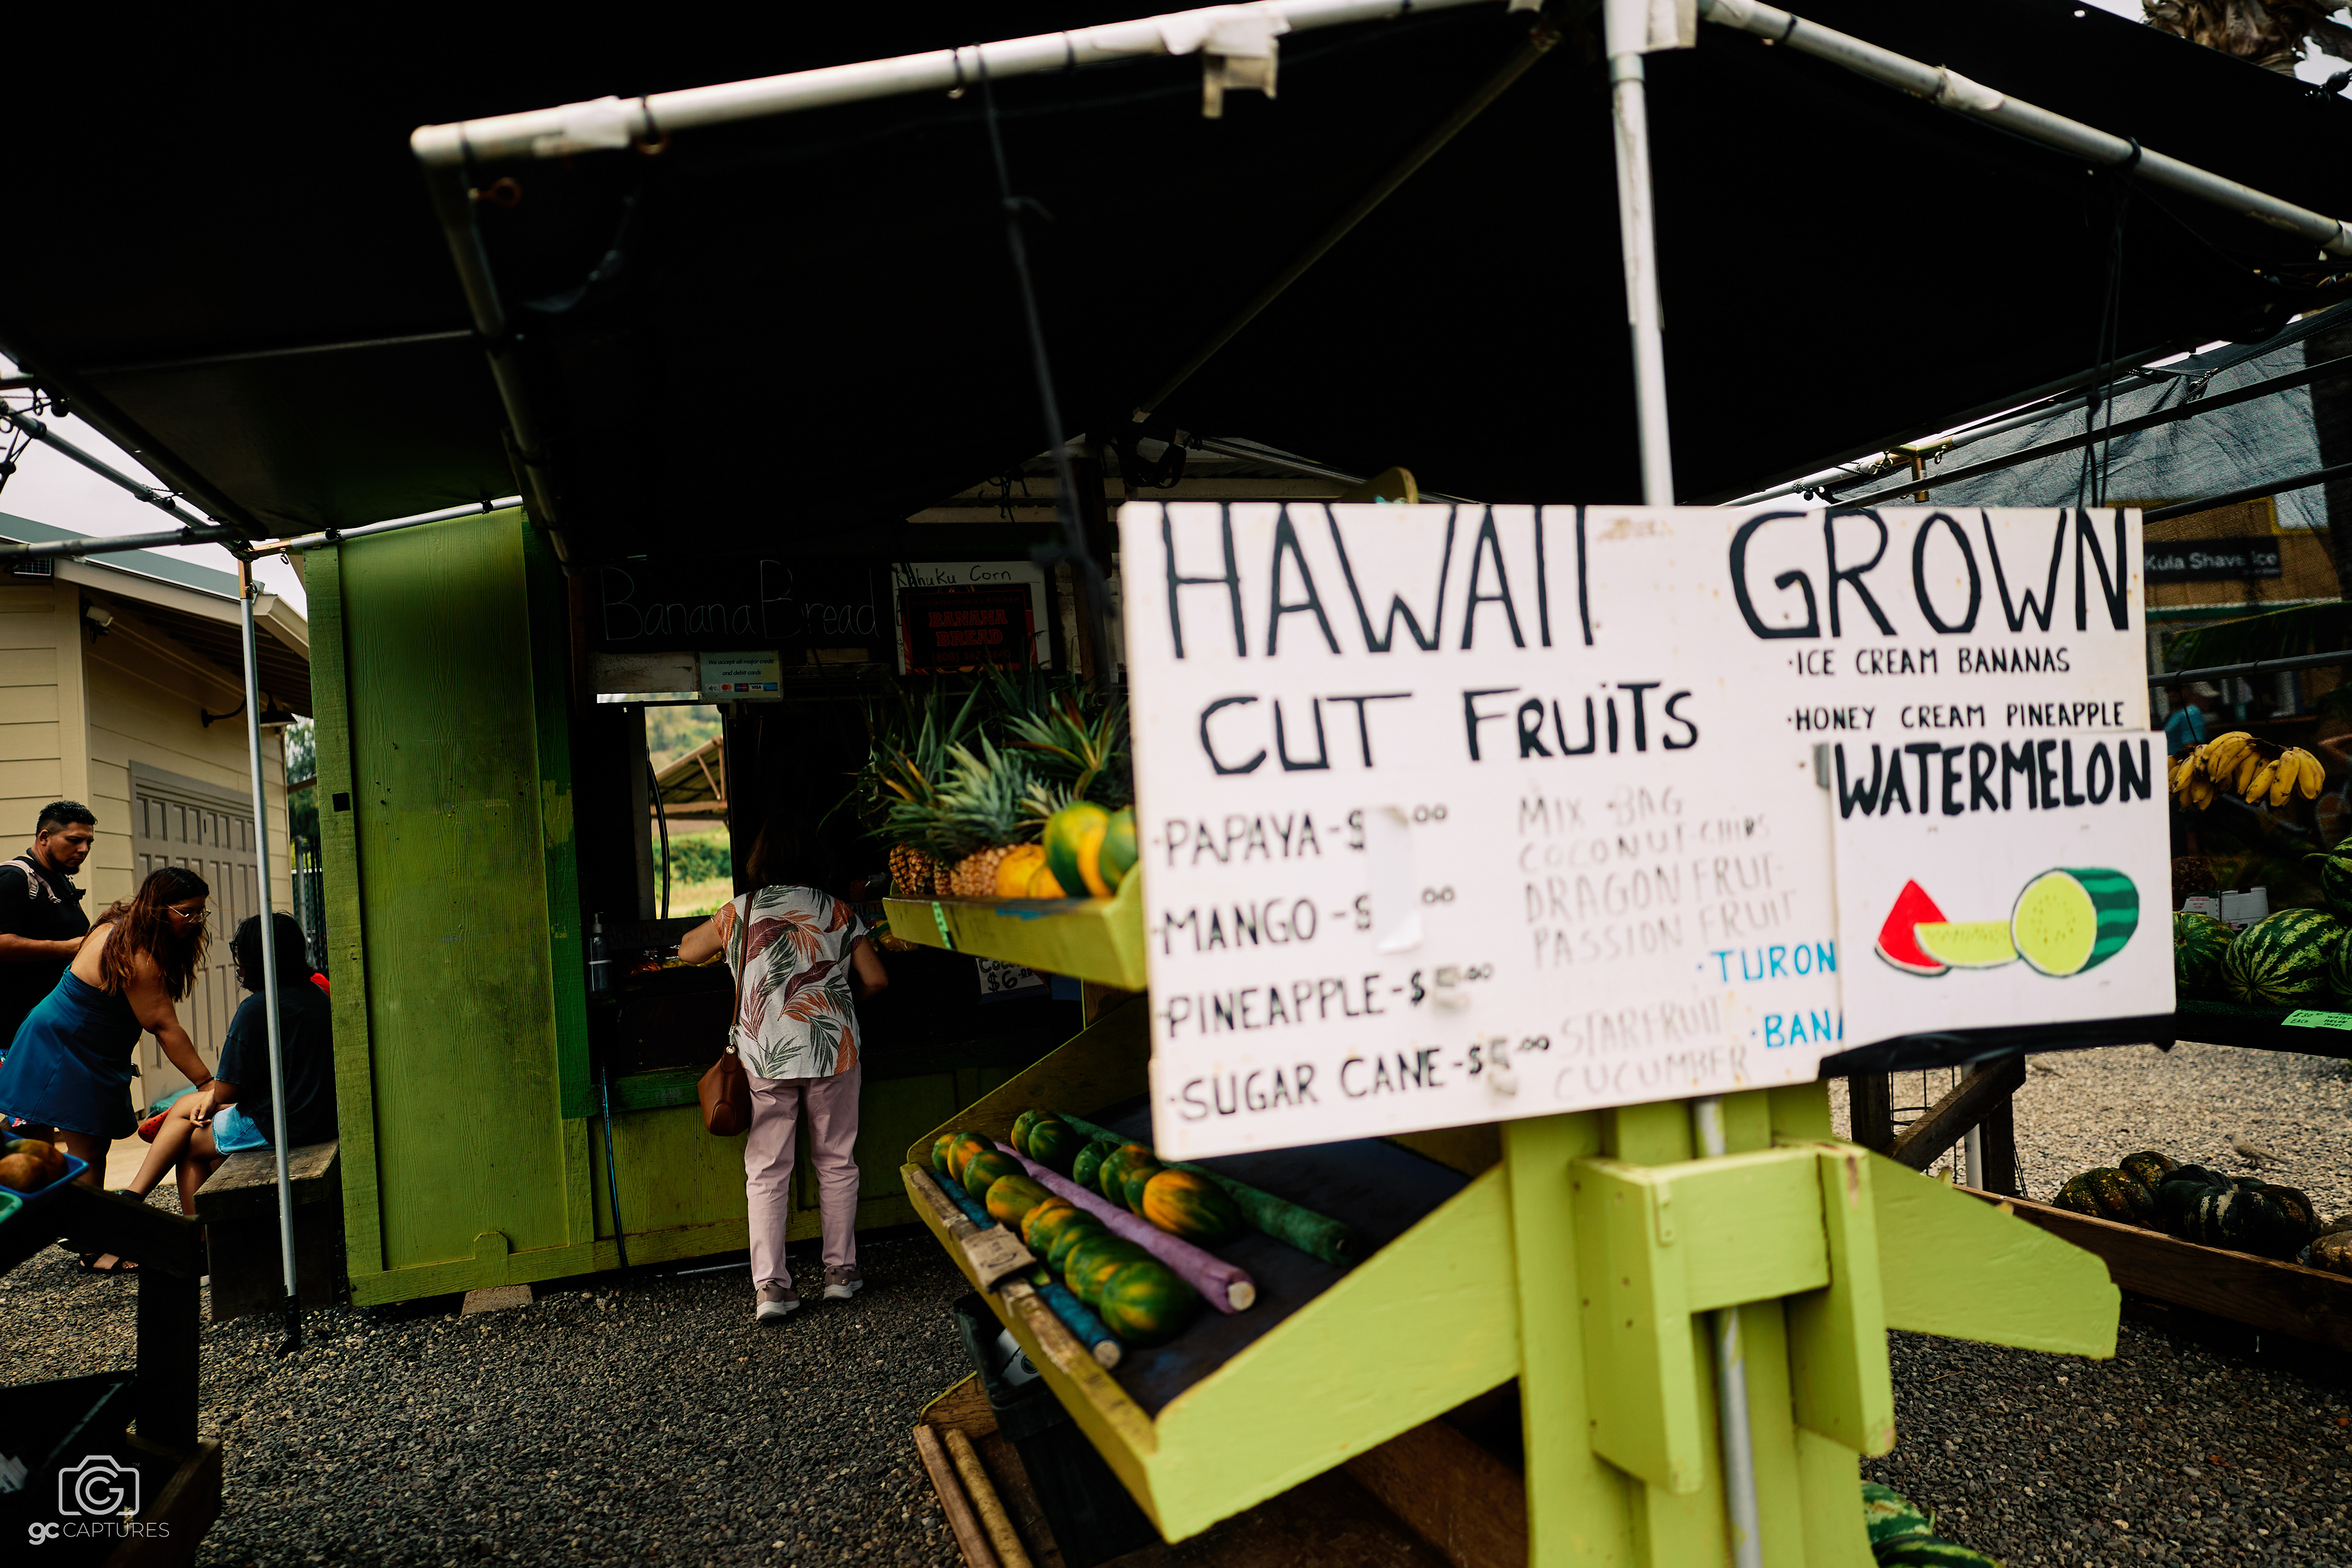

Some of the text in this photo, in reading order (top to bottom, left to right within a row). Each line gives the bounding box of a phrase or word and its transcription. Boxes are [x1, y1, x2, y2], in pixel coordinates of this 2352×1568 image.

[970, 565, 1011, 581] Corn
[1161, 503, 2130, 659] HAWAII GROWN
[601, 567, 756, 640] Banana
[760, 560, 880, 639] Bread
[987, 595, 1020, 604] Kitchen
[929, 609, 1008, 627] BANANA
[936, 629, 1003, 647] BREAD
[1797, 647, 2070, 676] ICE CREAM BANANAS
[1795, 701, 2124, 732] HONEY CREAM PINEAPPLE
[1199, 693, 1412, 776] CUT
[1834, 739, 2152, 820] WATERMELON
[1180, 1063, 1320, 1122] SUGAR
